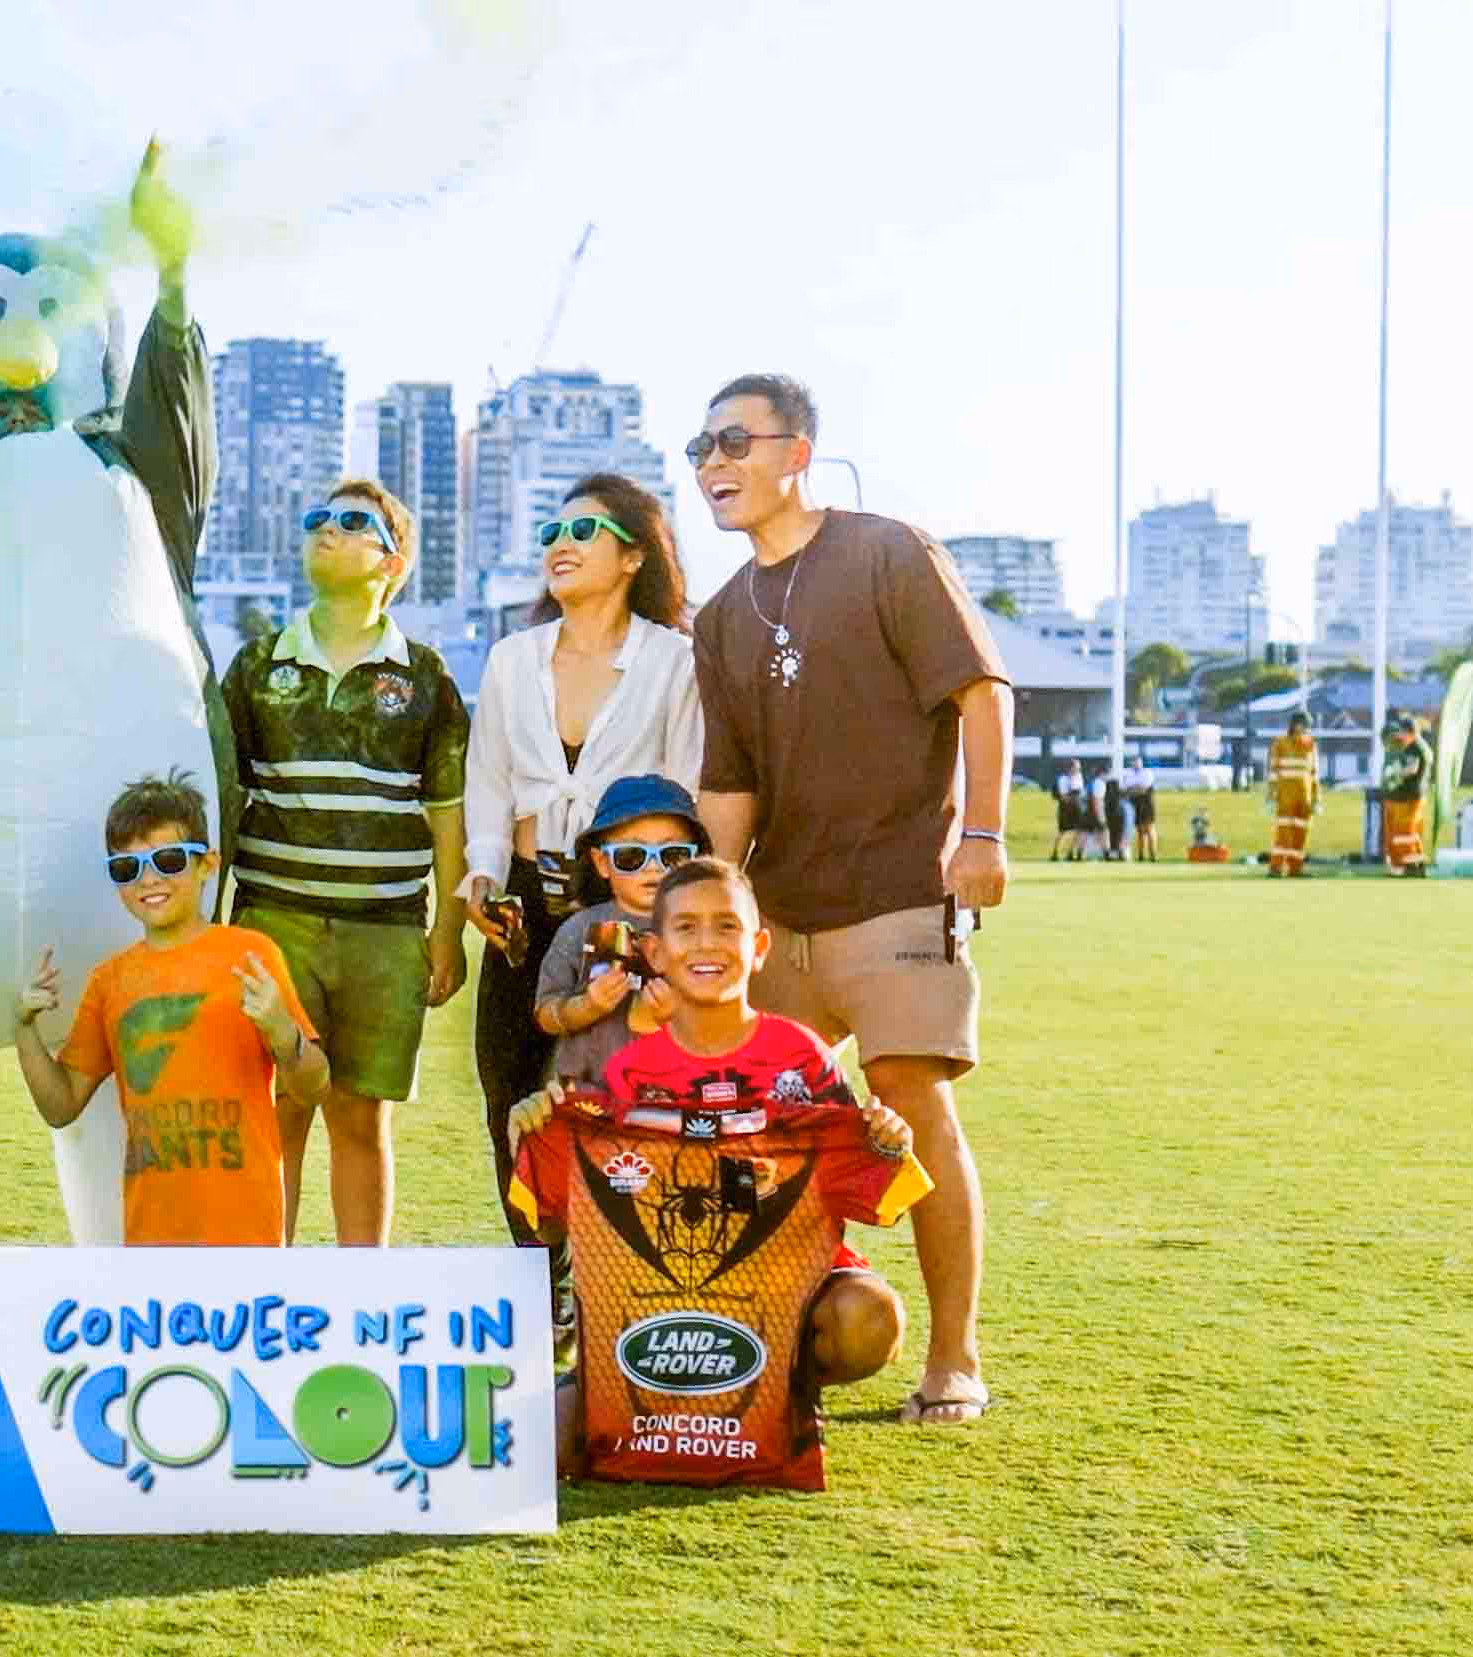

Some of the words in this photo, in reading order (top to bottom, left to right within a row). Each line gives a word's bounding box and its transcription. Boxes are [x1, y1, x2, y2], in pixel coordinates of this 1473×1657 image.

[44, 1295, 330, 1361] CONQUER
[354, 1304, 425, 1355] NF
[448, 1297, 514, 1353] IN
[647, 1331, 715, 1351] LAND
[651, 1353, 736, 1375] ROVER
[632, 1415, 741, 1436] CONCORD
[676, 1436, 758, 1459] ROVER
